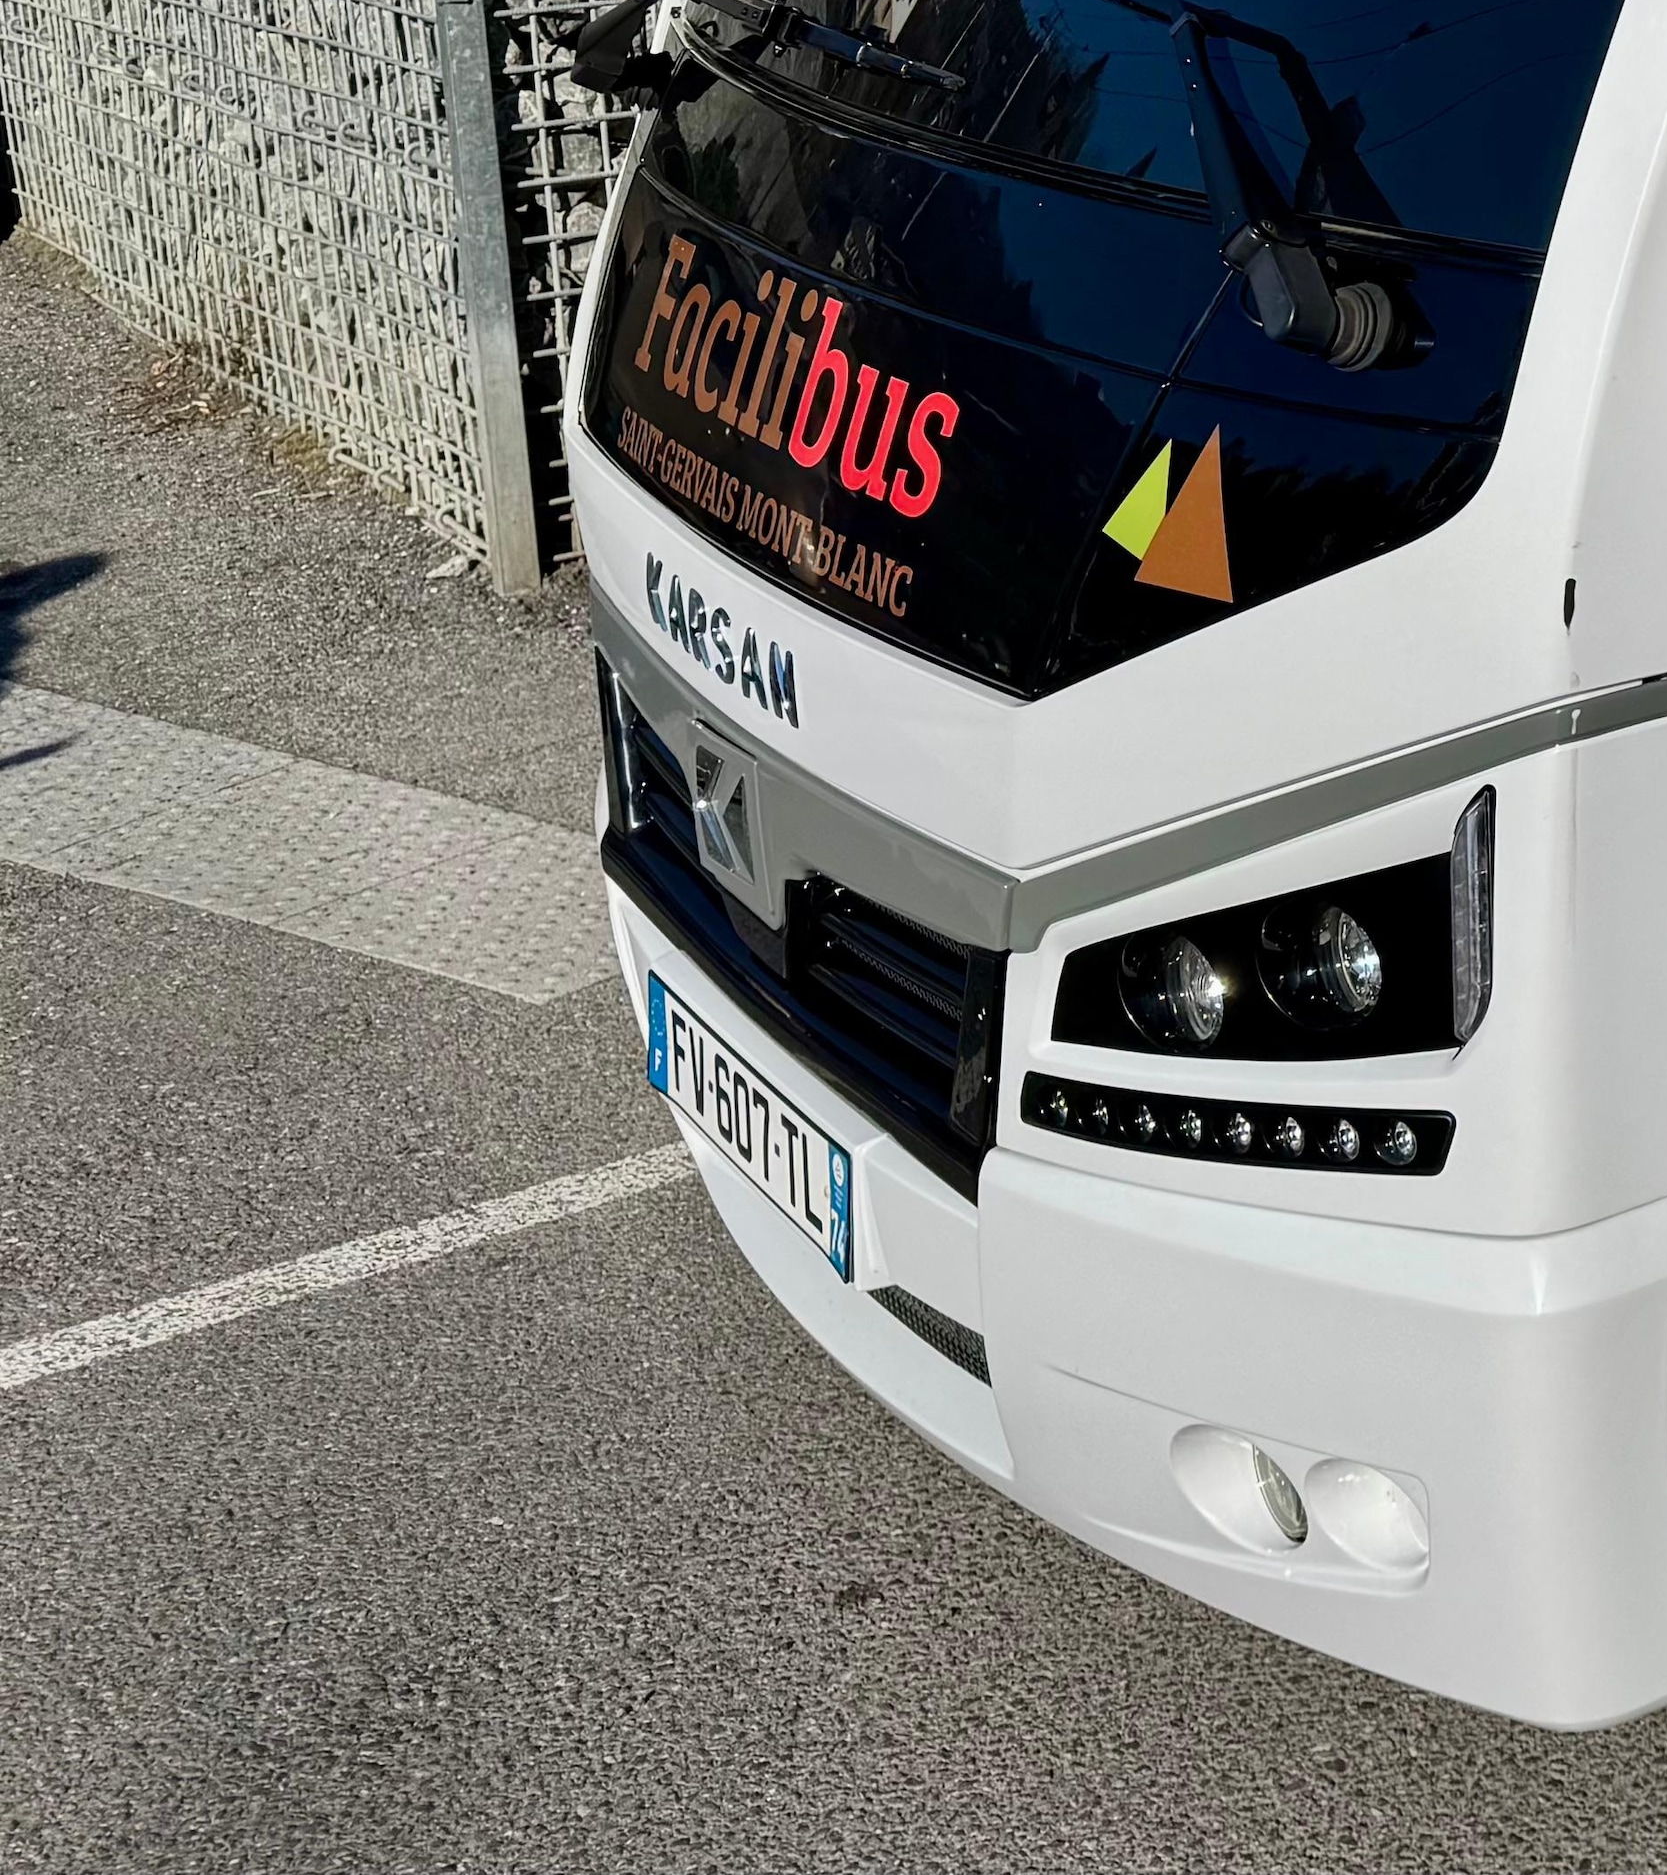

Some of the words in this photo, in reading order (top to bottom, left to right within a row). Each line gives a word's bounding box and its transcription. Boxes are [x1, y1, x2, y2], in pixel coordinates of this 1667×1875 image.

[634, 233, 961, 518] Facilibus
[617, 405, 740, 524] SAINT-GERVAIS
[646, 551, 800, 729] KARSAN
[654, 1047, 662, 1072] F
[671, 1009, 824, 1235] FV-607-TL
[830, 1209, 850, 1263] 74
